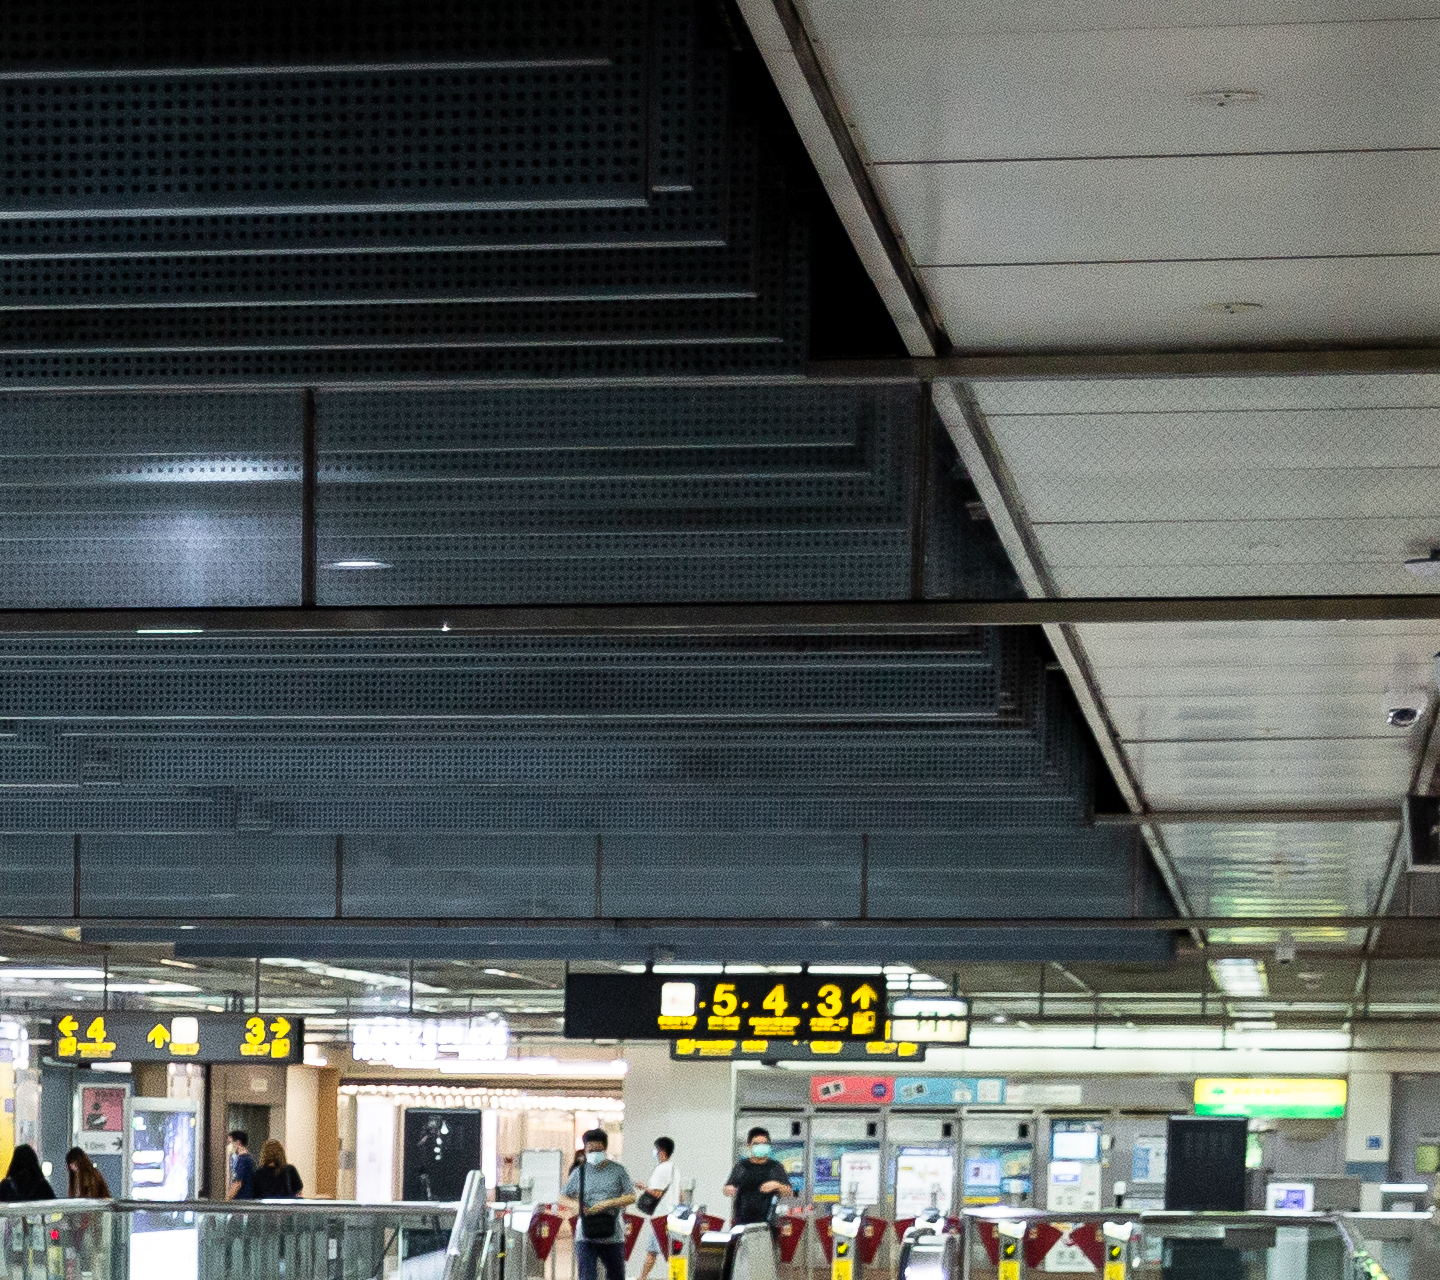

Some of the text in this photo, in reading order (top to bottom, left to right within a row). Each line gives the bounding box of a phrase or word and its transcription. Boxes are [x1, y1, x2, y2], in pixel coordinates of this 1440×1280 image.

[712, 983, 842, 1017] 5 4 3
[86, 1017, 107, 1043] 4
[245, 1017, 266, 1044] 3
